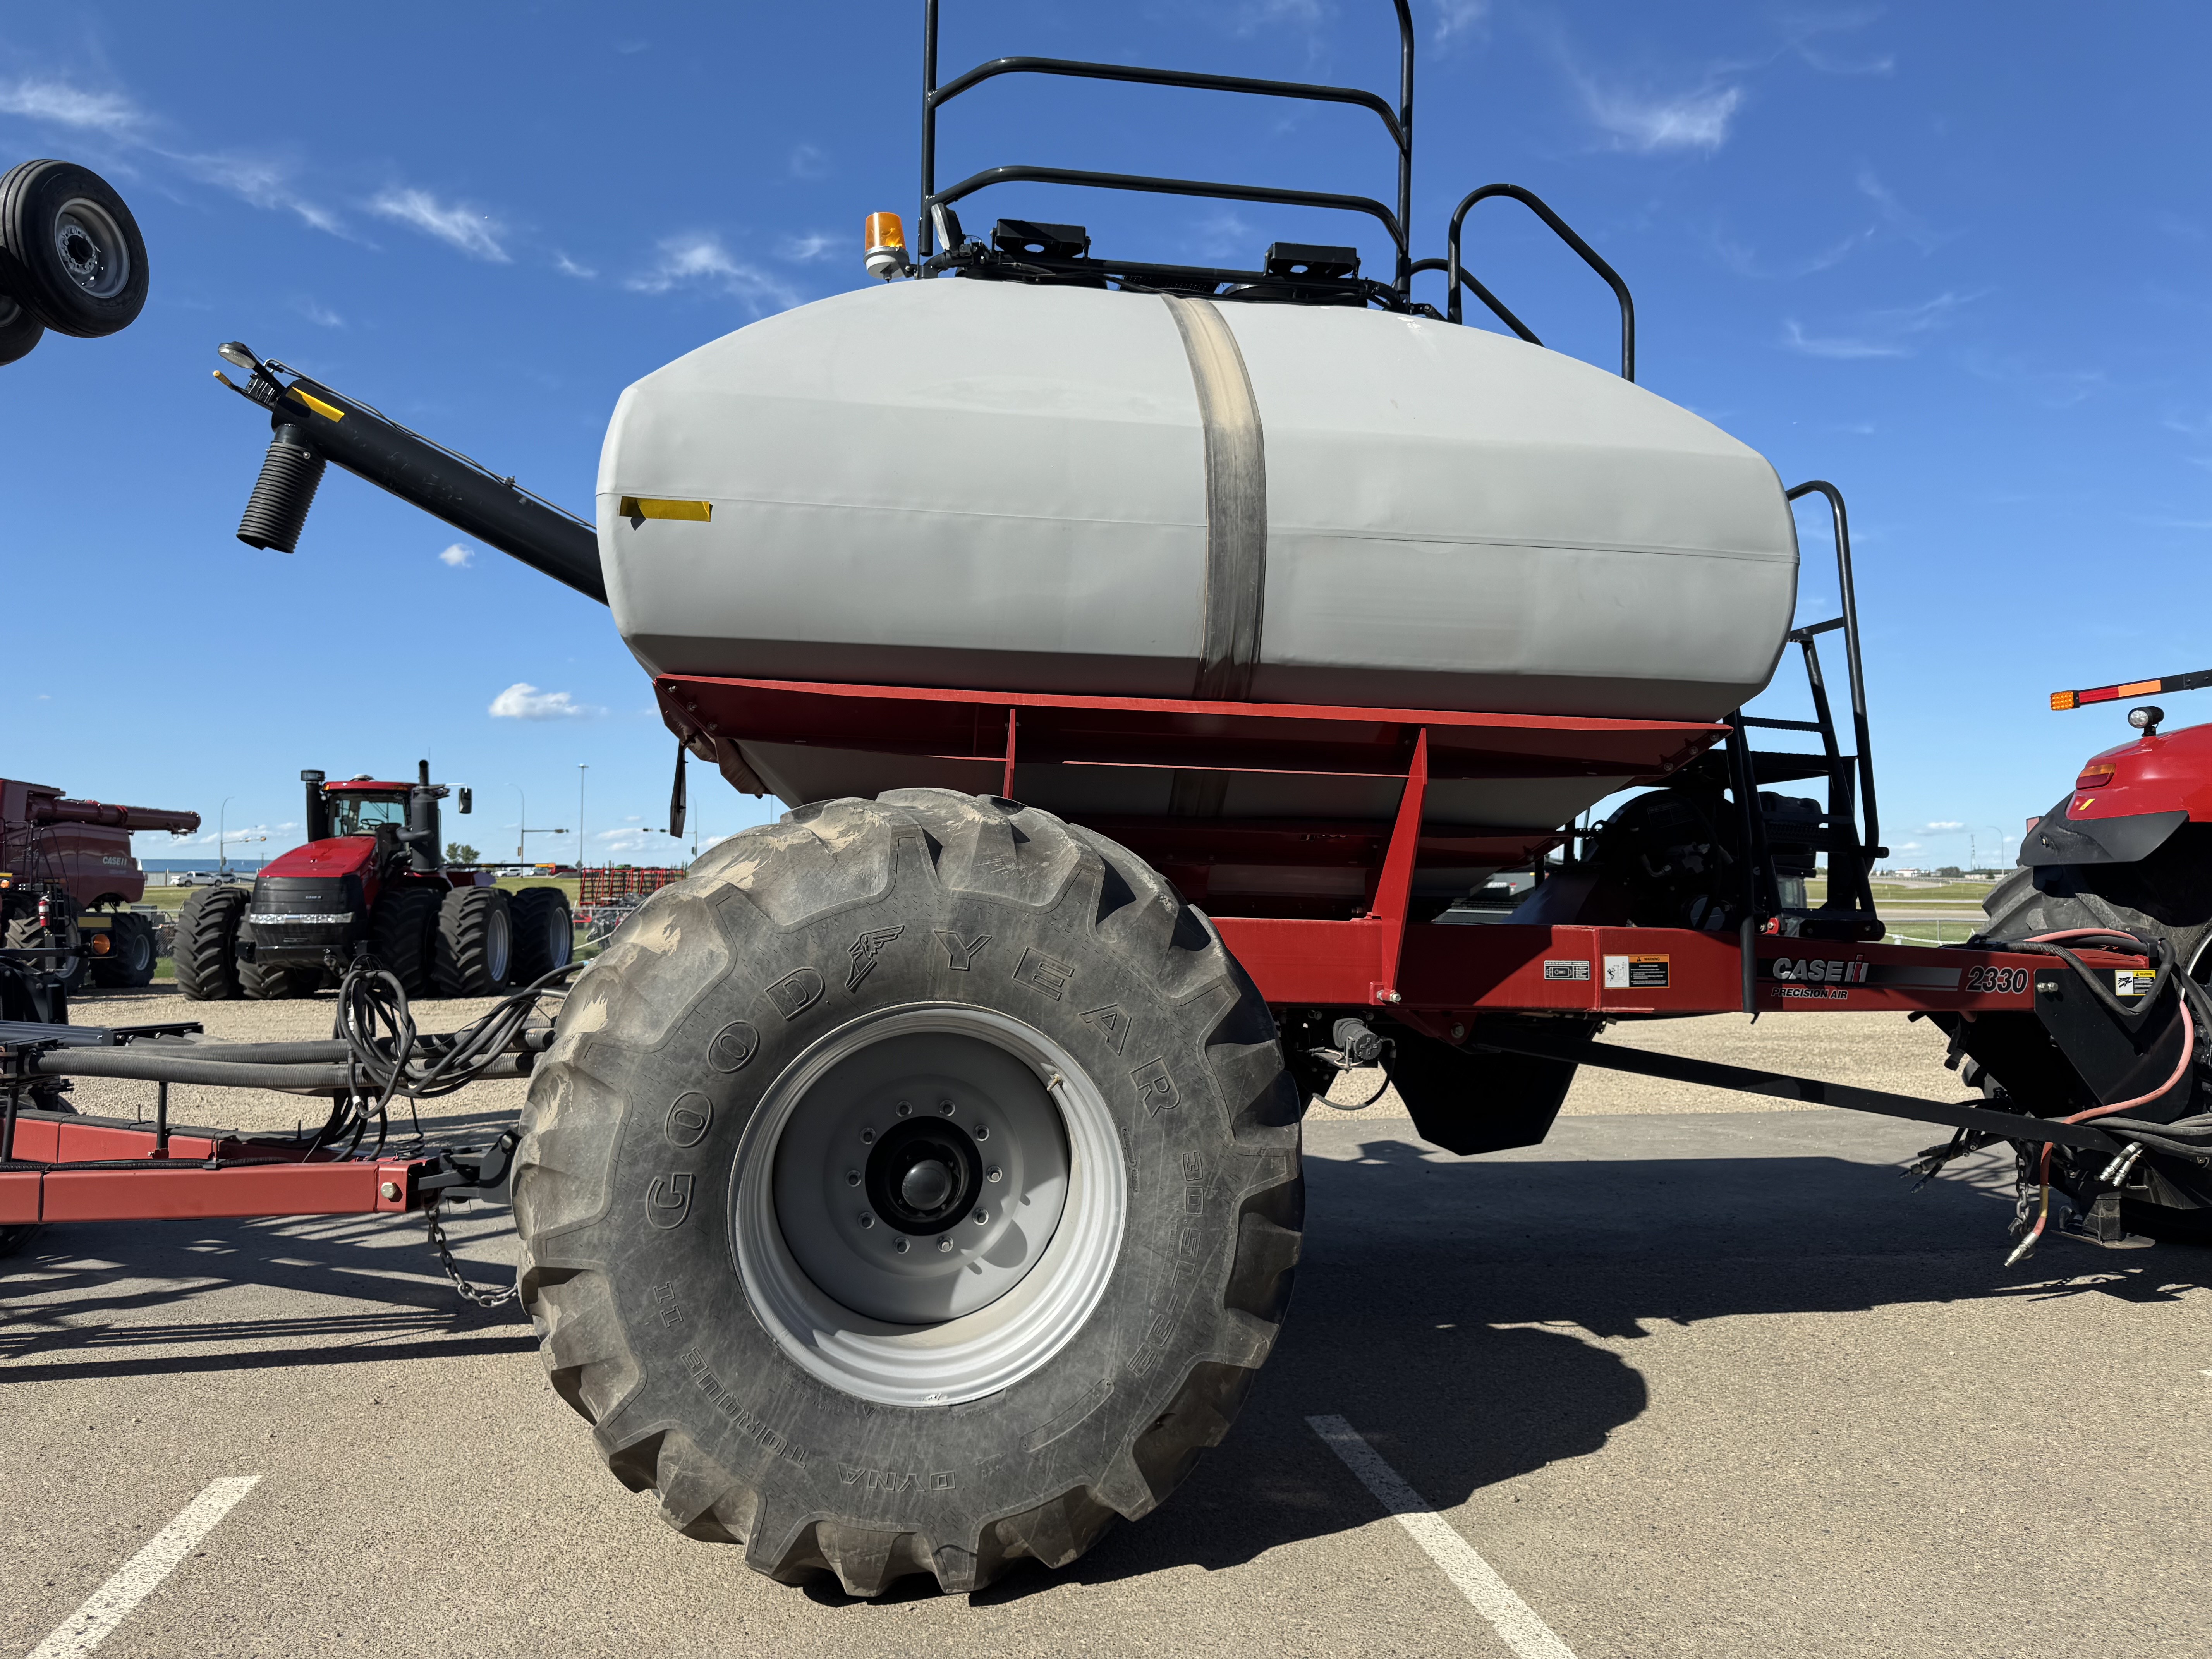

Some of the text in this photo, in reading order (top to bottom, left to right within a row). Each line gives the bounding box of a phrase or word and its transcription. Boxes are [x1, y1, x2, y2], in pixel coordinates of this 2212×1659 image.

[1773, 957, 1844, 981] CASE
[1965, 965, 2029, 994] 2330
[1771, 987, 1848, 1000] PRECISION AIR
[646, 929, 1182, 1230] GOODYEAR
[681, 1346, 806, 1469] TORQUE
[838, 1462, 957, 1492] DYNA
